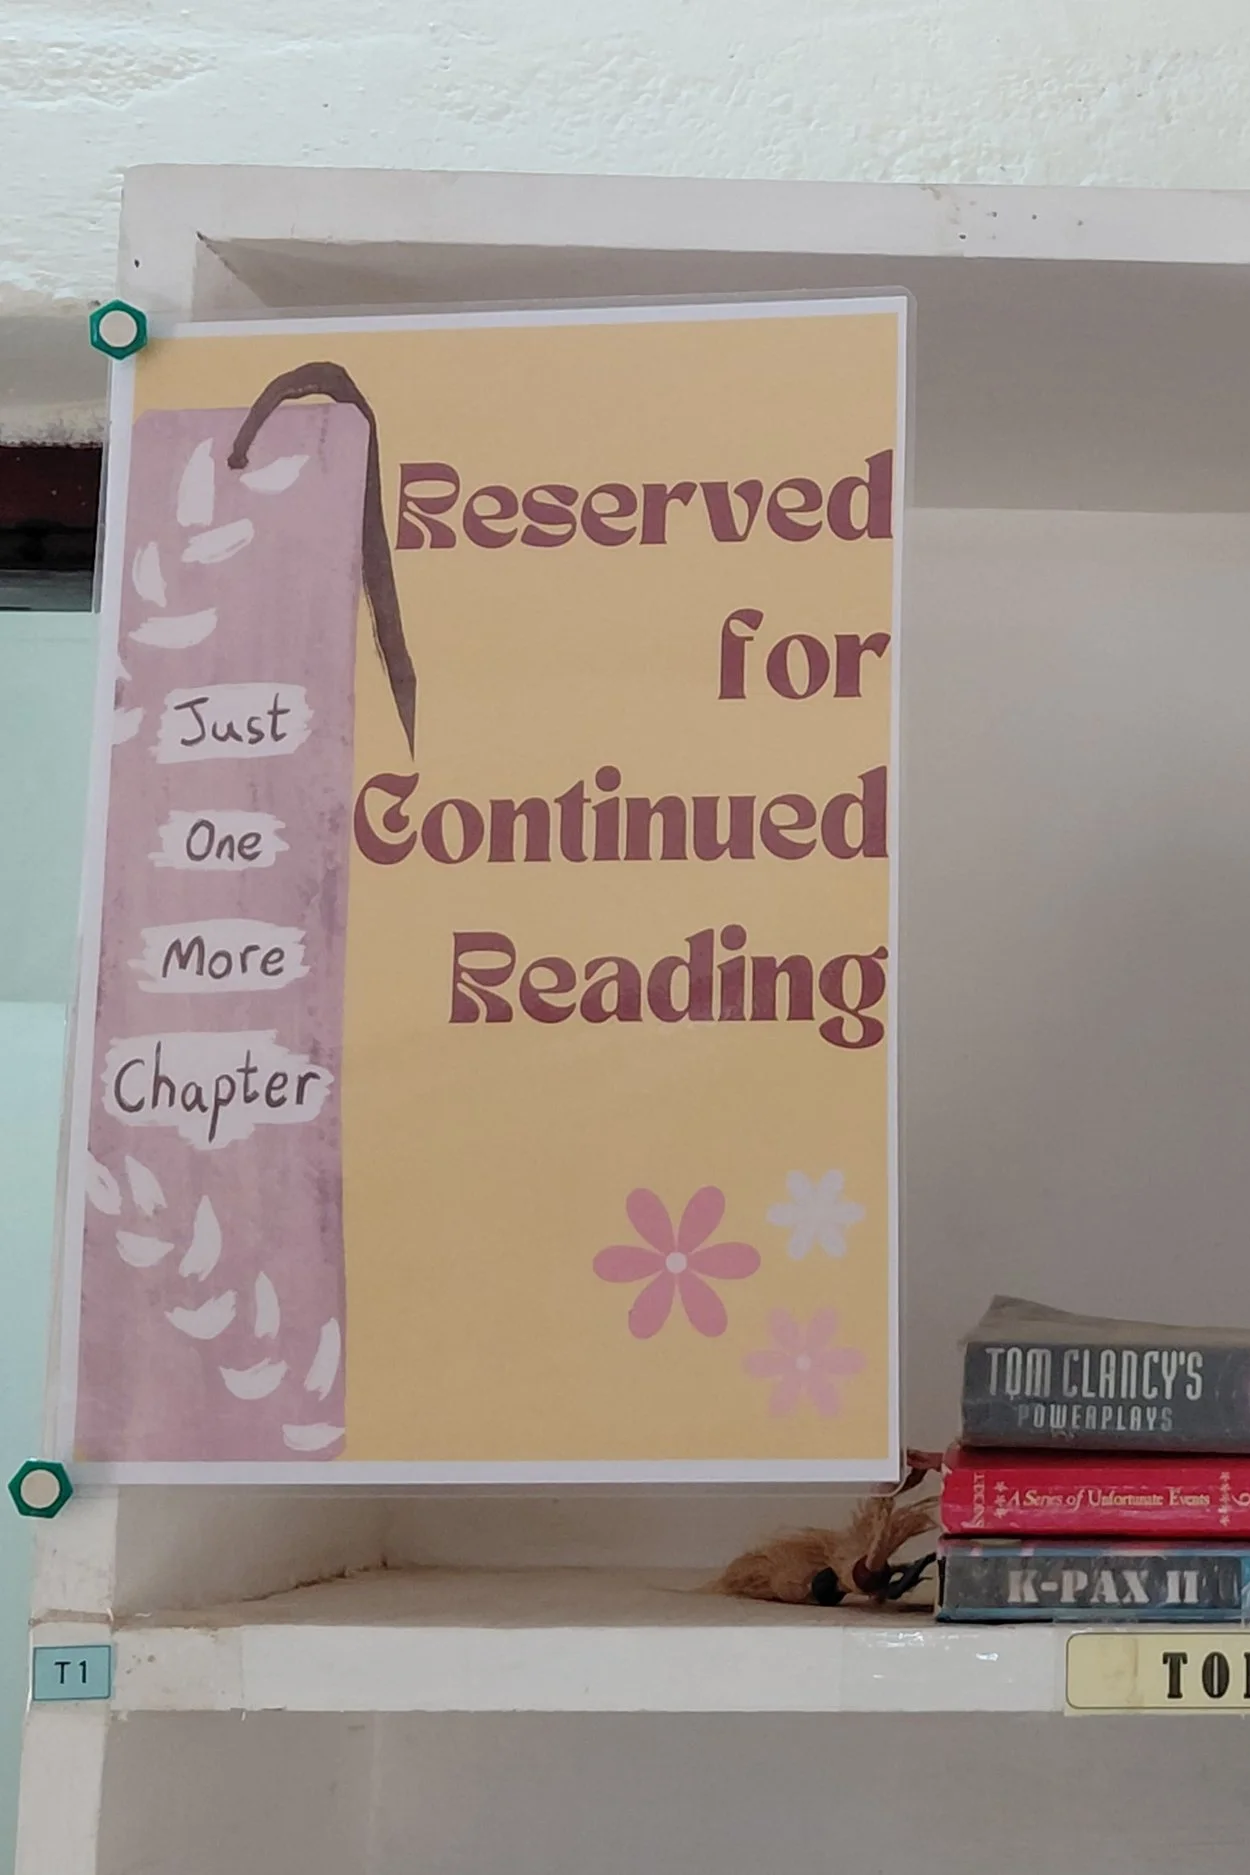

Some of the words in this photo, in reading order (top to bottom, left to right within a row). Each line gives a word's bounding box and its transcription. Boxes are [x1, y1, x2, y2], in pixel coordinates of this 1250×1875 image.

[394, 448, 895, 551] Reserved
[717, 608, 892, 701] for
[173, 692, 290, 747] Just
[185, 818, 263, 862] One
[352, 765, 890, 866] Continued
[161, 935, 285, 980] More
[448, 924, 889, 1050] Reading
[113, 1041, 321, 1143] Chapter
[984, 1346, 1052, 1400] TOM
[1062, 1348, 1204, 1401] CLANCY'S
[1066, 1486, 1085, 1513] of
[1168, 1487, 1211, 1507] Events
[1007, 1569, 1150, 1605] K-PAX
[1165, 1569, 1200, 1605] II
[54, 1660, 89, 1684] T1
